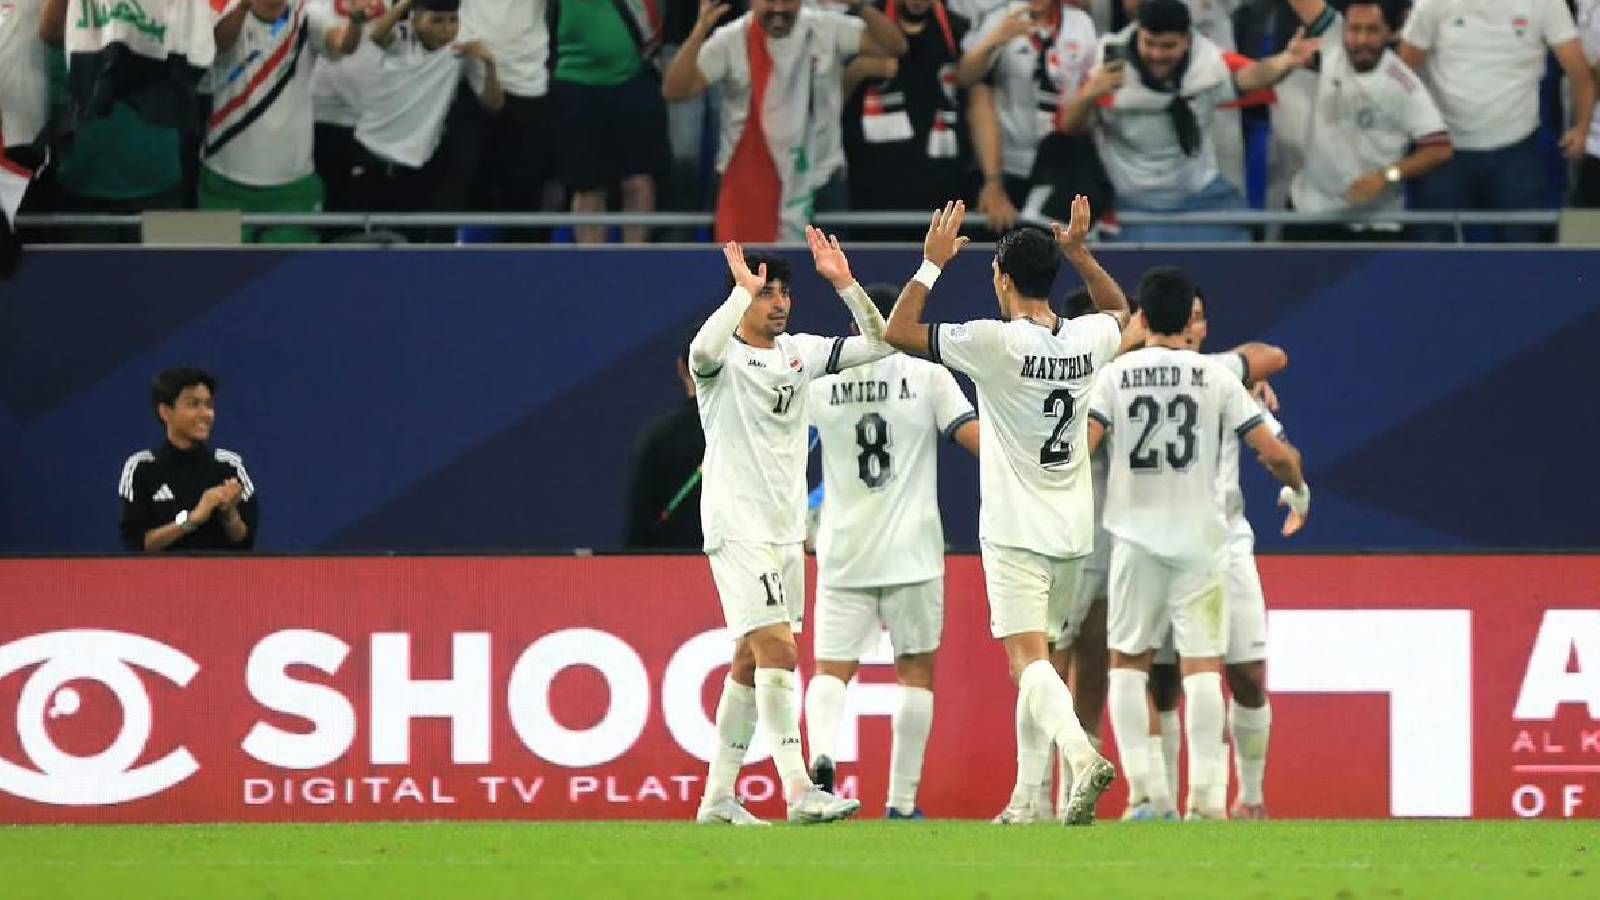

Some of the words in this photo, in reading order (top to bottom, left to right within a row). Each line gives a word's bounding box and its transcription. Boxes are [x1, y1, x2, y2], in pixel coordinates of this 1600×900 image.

[830, 380, 888, 406] AMJED
[898, 377, 917, 400] A.
[1120, 366, 1181, 389] AHMED
[1191, 366, 1208, 388] M.
[772, 385, 795, 414] 17
[1040, 388, 1075, 470] 2
[1128, 394, 1199, 474] 23
[855, 412, 894, 491] 8
[1511, 729, 1564, 752] AL
[243, 776, 455, 805] DIGITAL
[478, 776, 544, 804] TV
[569, 775, 859, 804] PLATOM
